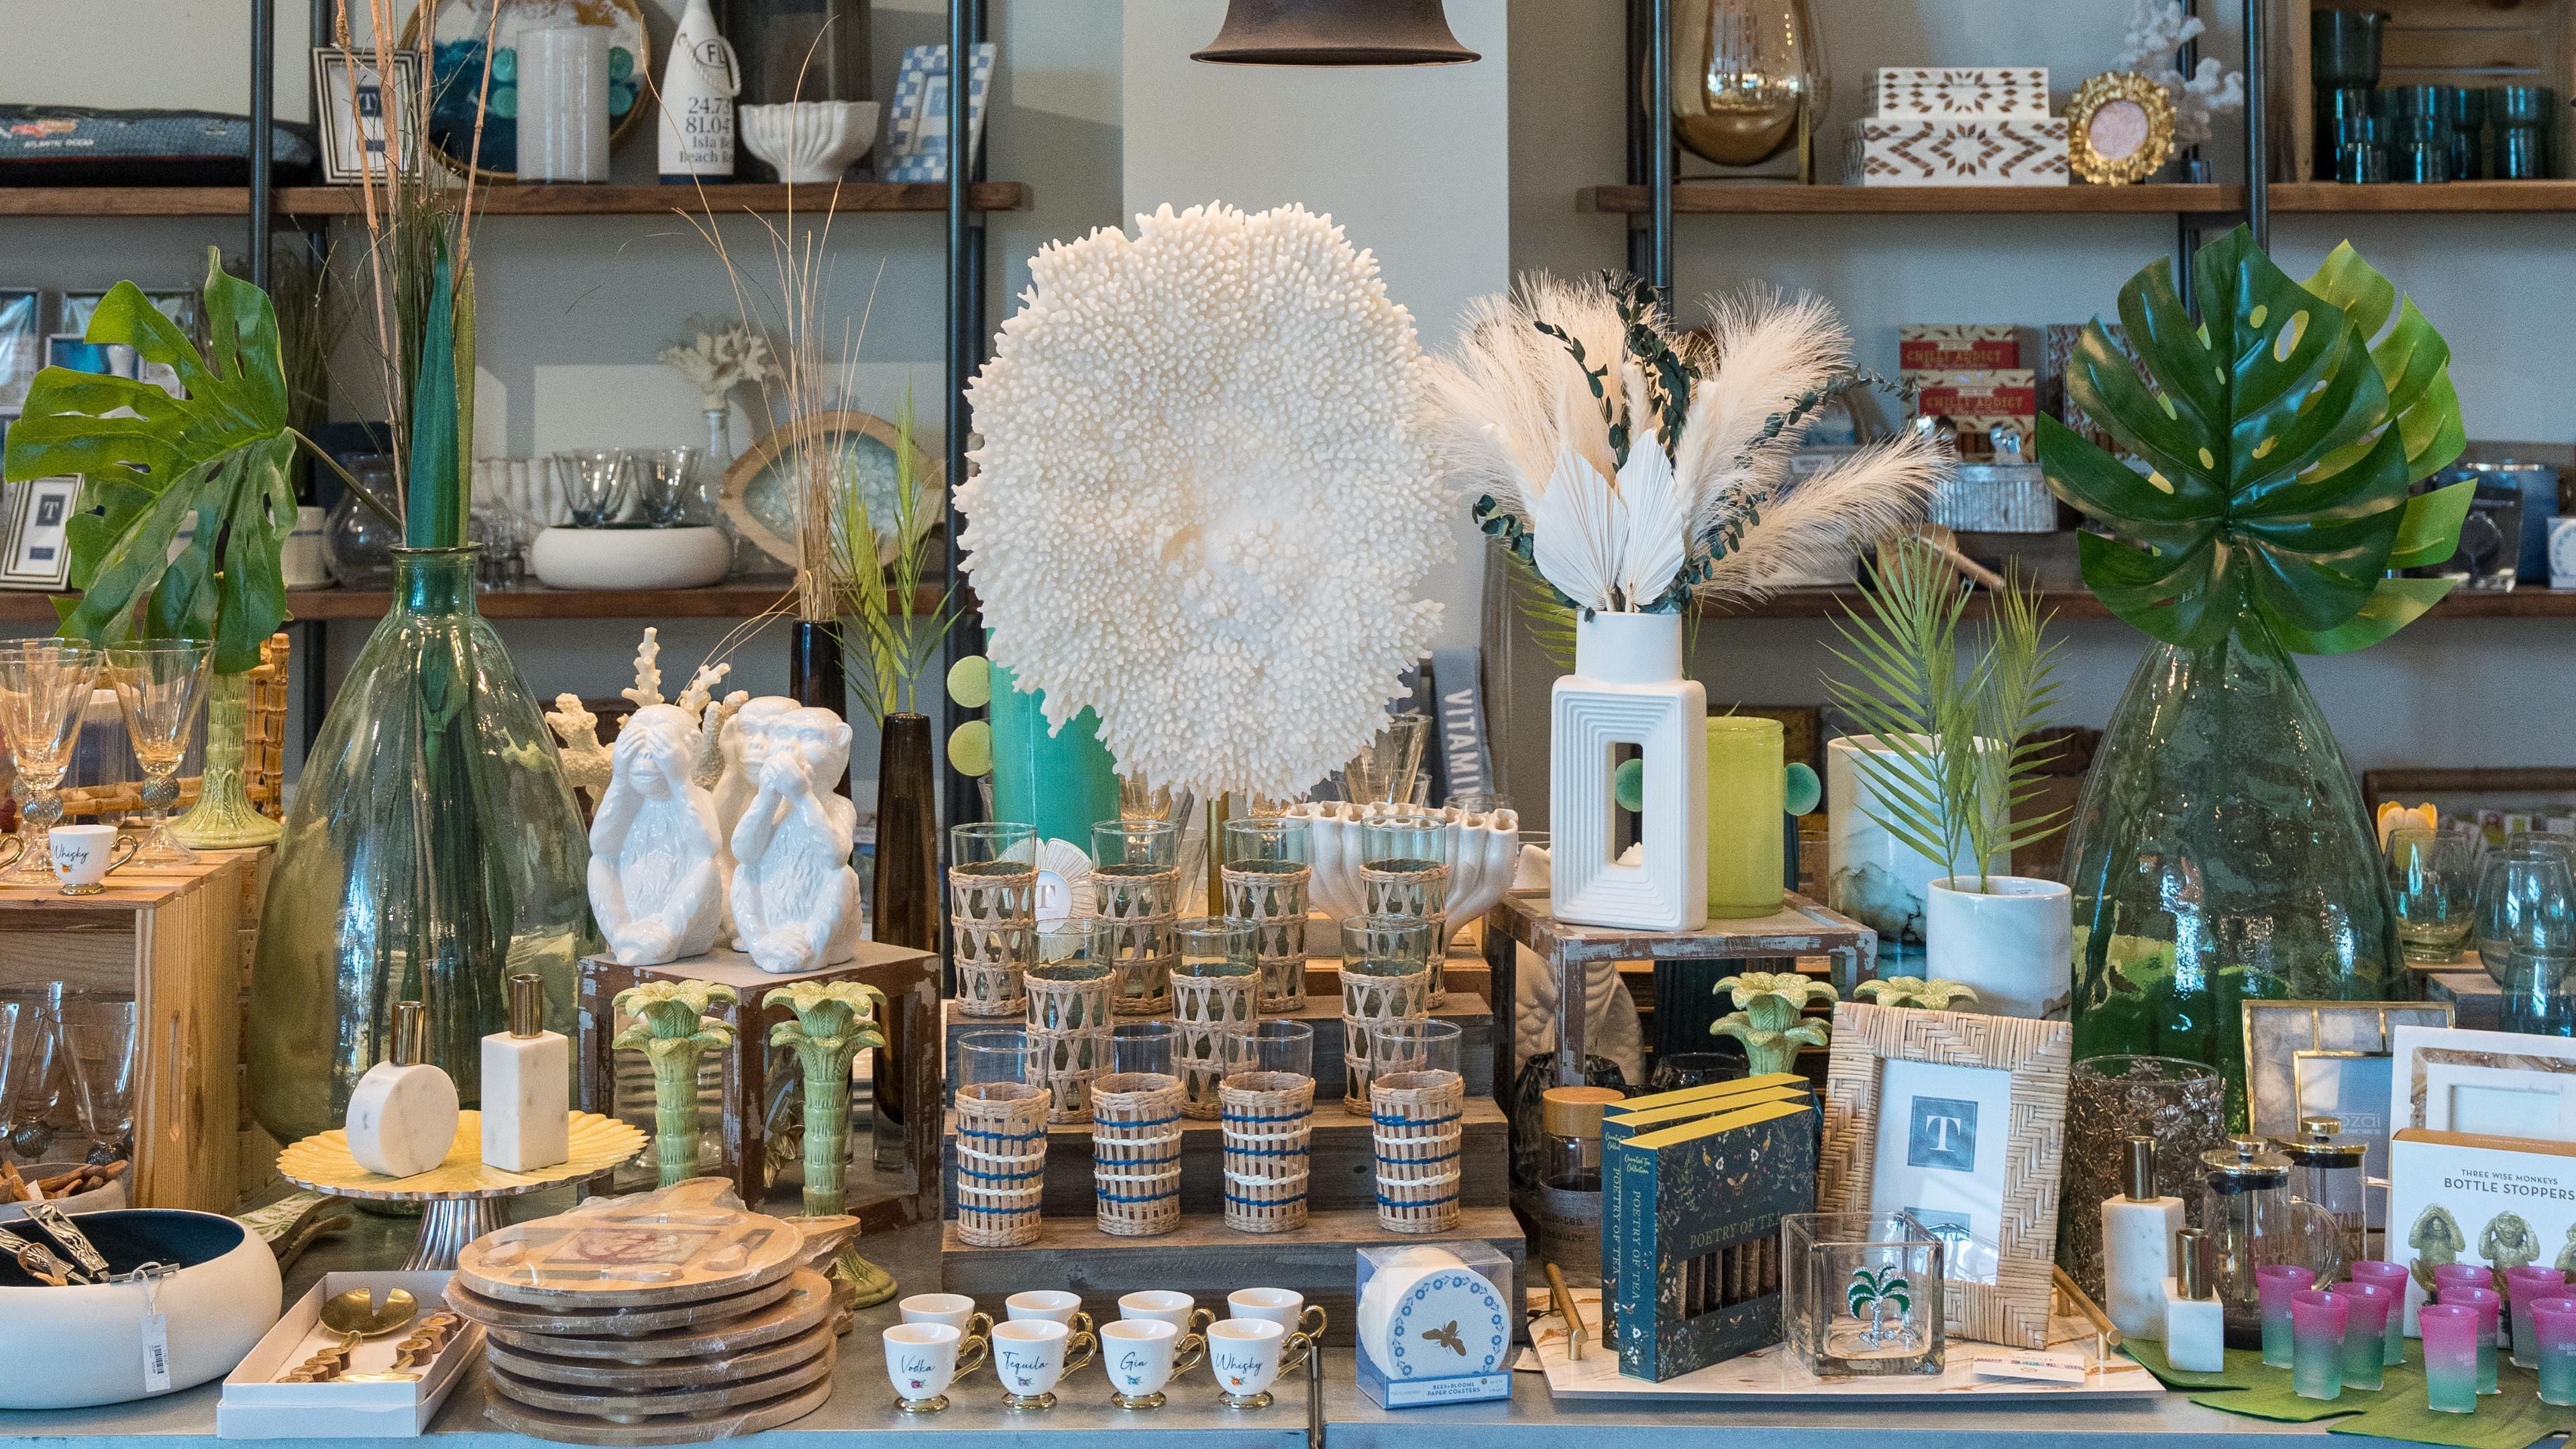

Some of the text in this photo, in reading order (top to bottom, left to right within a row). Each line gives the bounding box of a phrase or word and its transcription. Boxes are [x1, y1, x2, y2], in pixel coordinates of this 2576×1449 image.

[706, 44, 727, 64] FL
[693, 136, 716, 148] Isla
[1955, 349, 2002, 363] ADDICT
[1978, 396, 2023, 409] ADDICT
[44, 501, 59, 519] T
[53, 843, 89, 864] Whisky
[1925, 1115, 1962, 1152] T
[2461, 1169, 2558, 1185] THREE WISE MONKEYS
[2445, 1177, 2575, 1201] BOTTLE STOPPERS
[1613, 1168, 1621, 1275] POETRY OF TEA
[1690, 1211, 1782, 1249] POETRY OF TEA
[1632, 1191, 1642, 1299] POETRY OF TEA
[901, 1354, 935, 1373] Vodka
[1003, 1351, 1049, 1375] Tequila
[1120, 1351, 1148, 1371] Gin
[1216, 1352, 1263, 1377] Whisky
[1448, 1387, 1481, 1395] COASTERS
